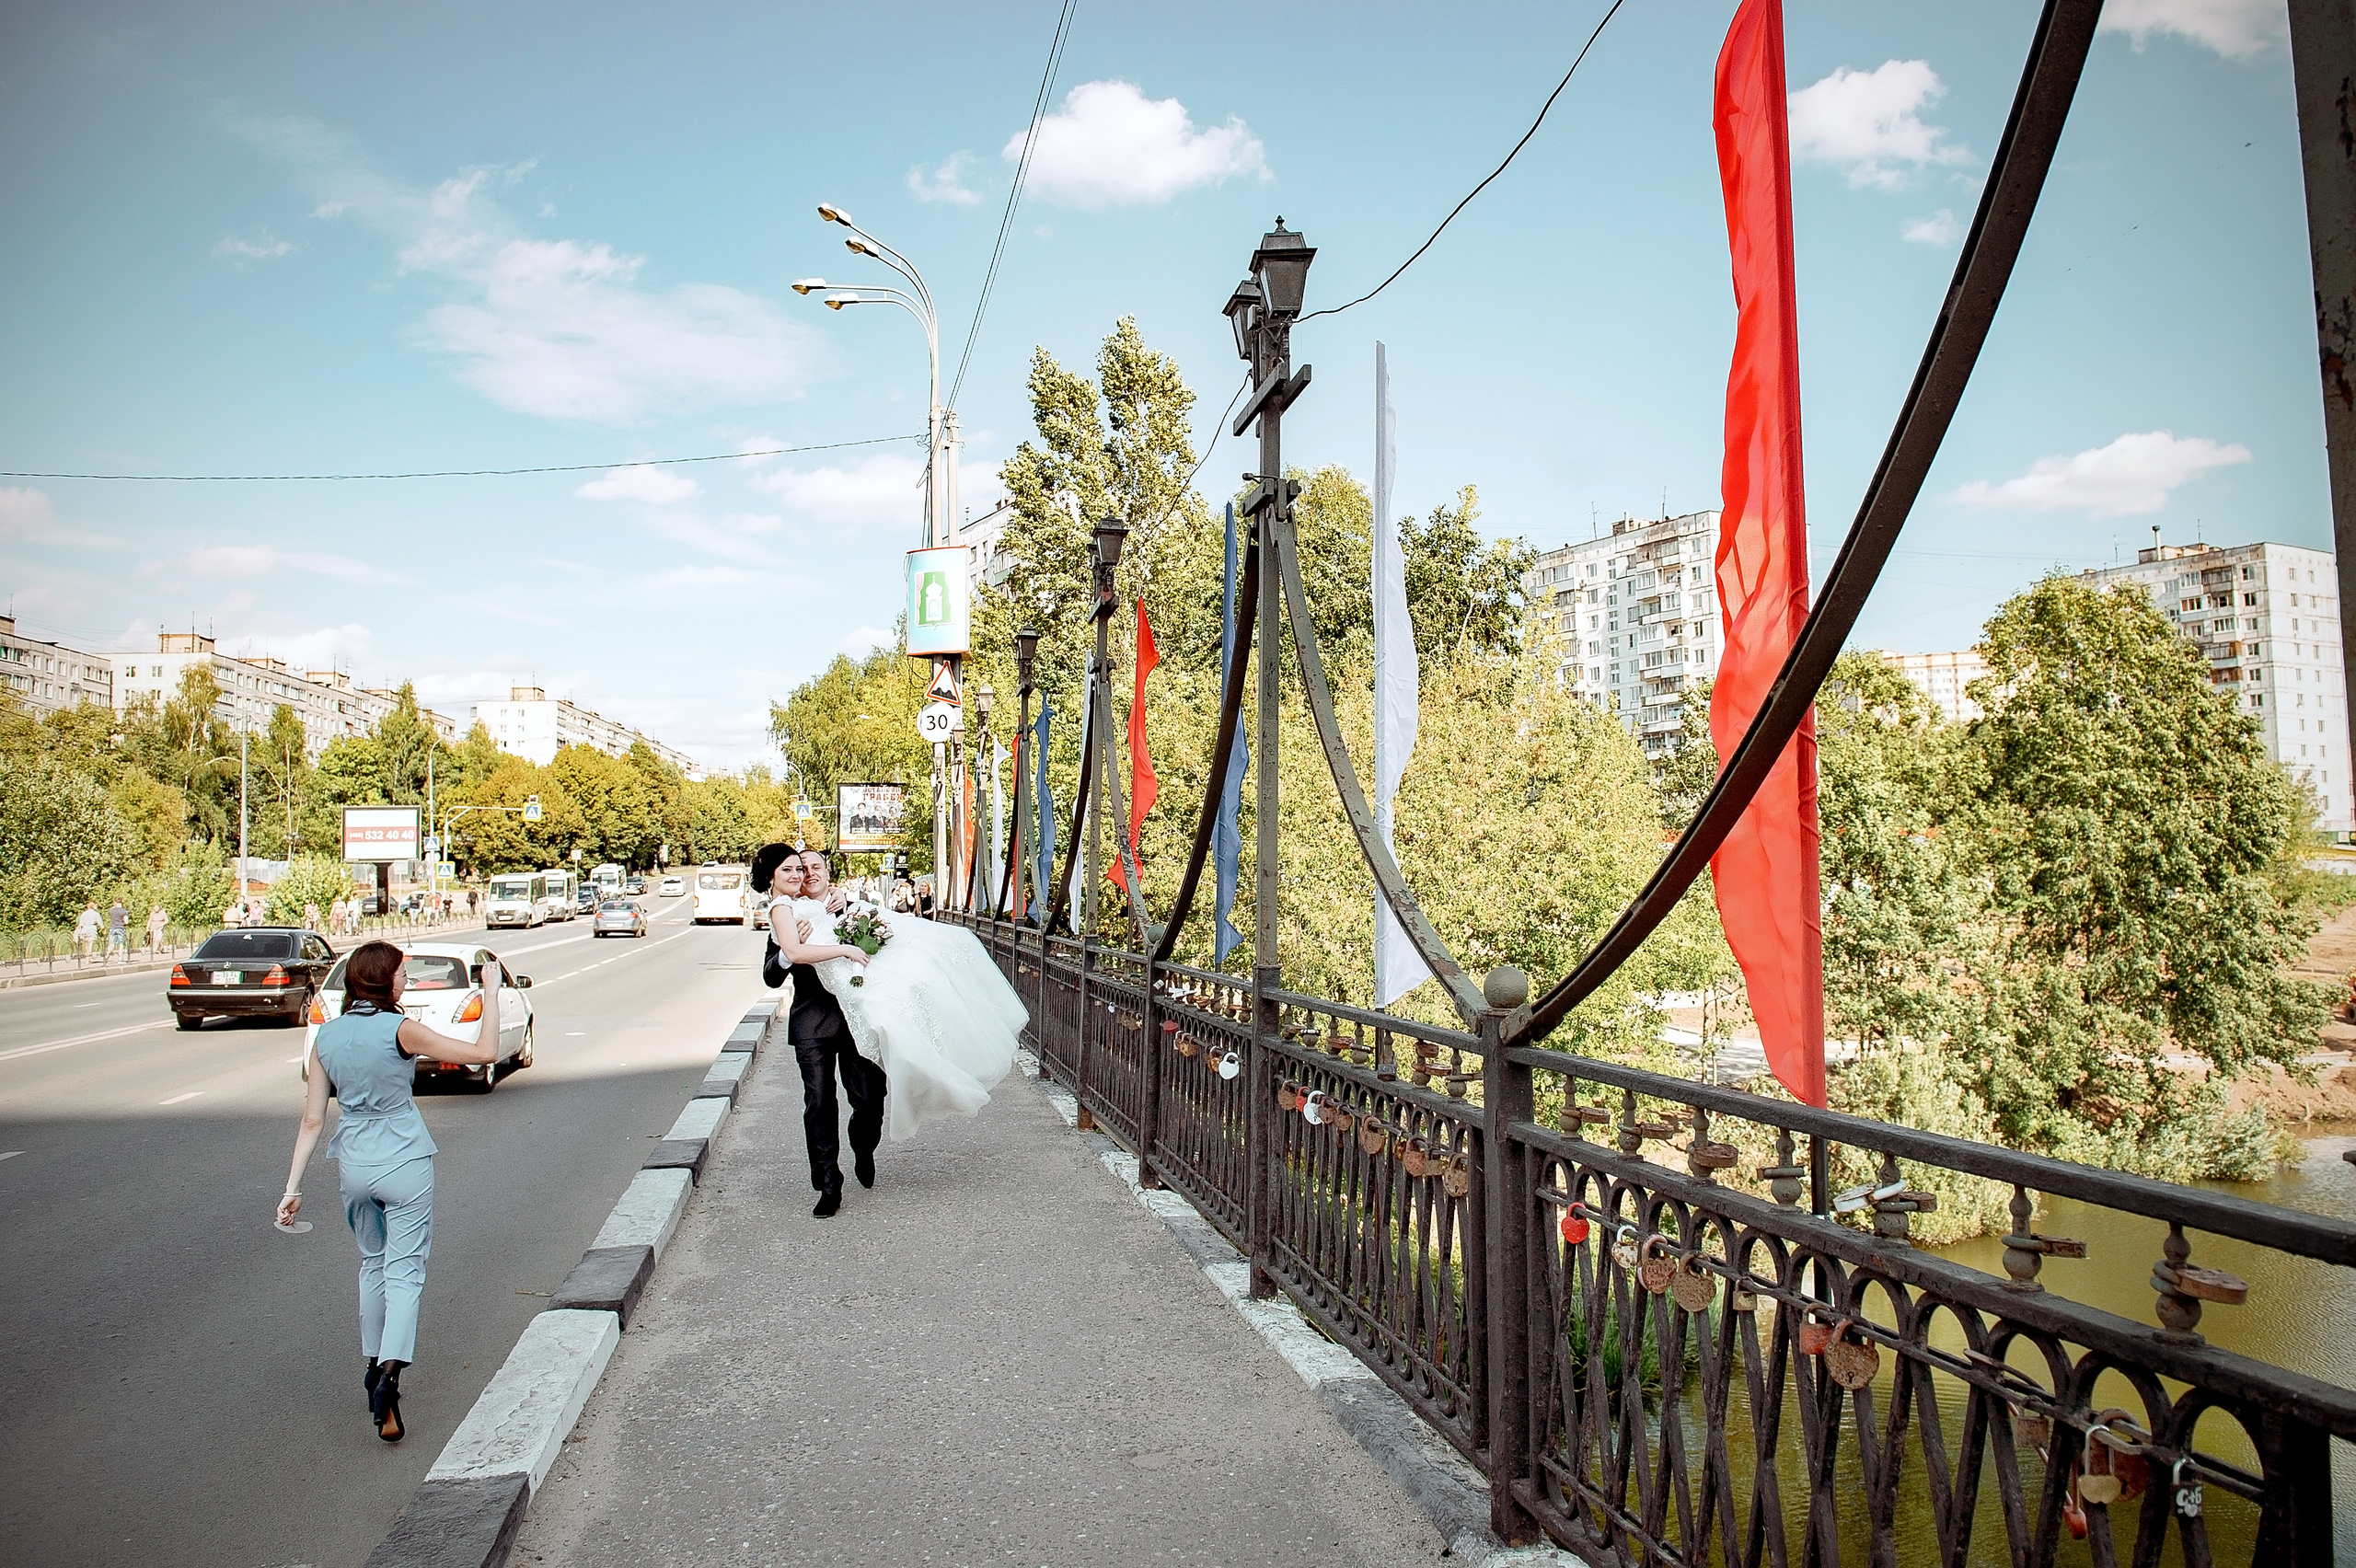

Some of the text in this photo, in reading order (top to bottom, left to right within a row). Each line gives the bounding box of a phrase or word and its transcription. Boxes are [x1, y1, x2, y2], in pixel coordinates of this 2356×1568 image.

[926, 714, 948, 731] 30
[364, 830, 384, 840] 532
[386, 830, 399, 840] 40
[401, 830, 415, 840] 40
